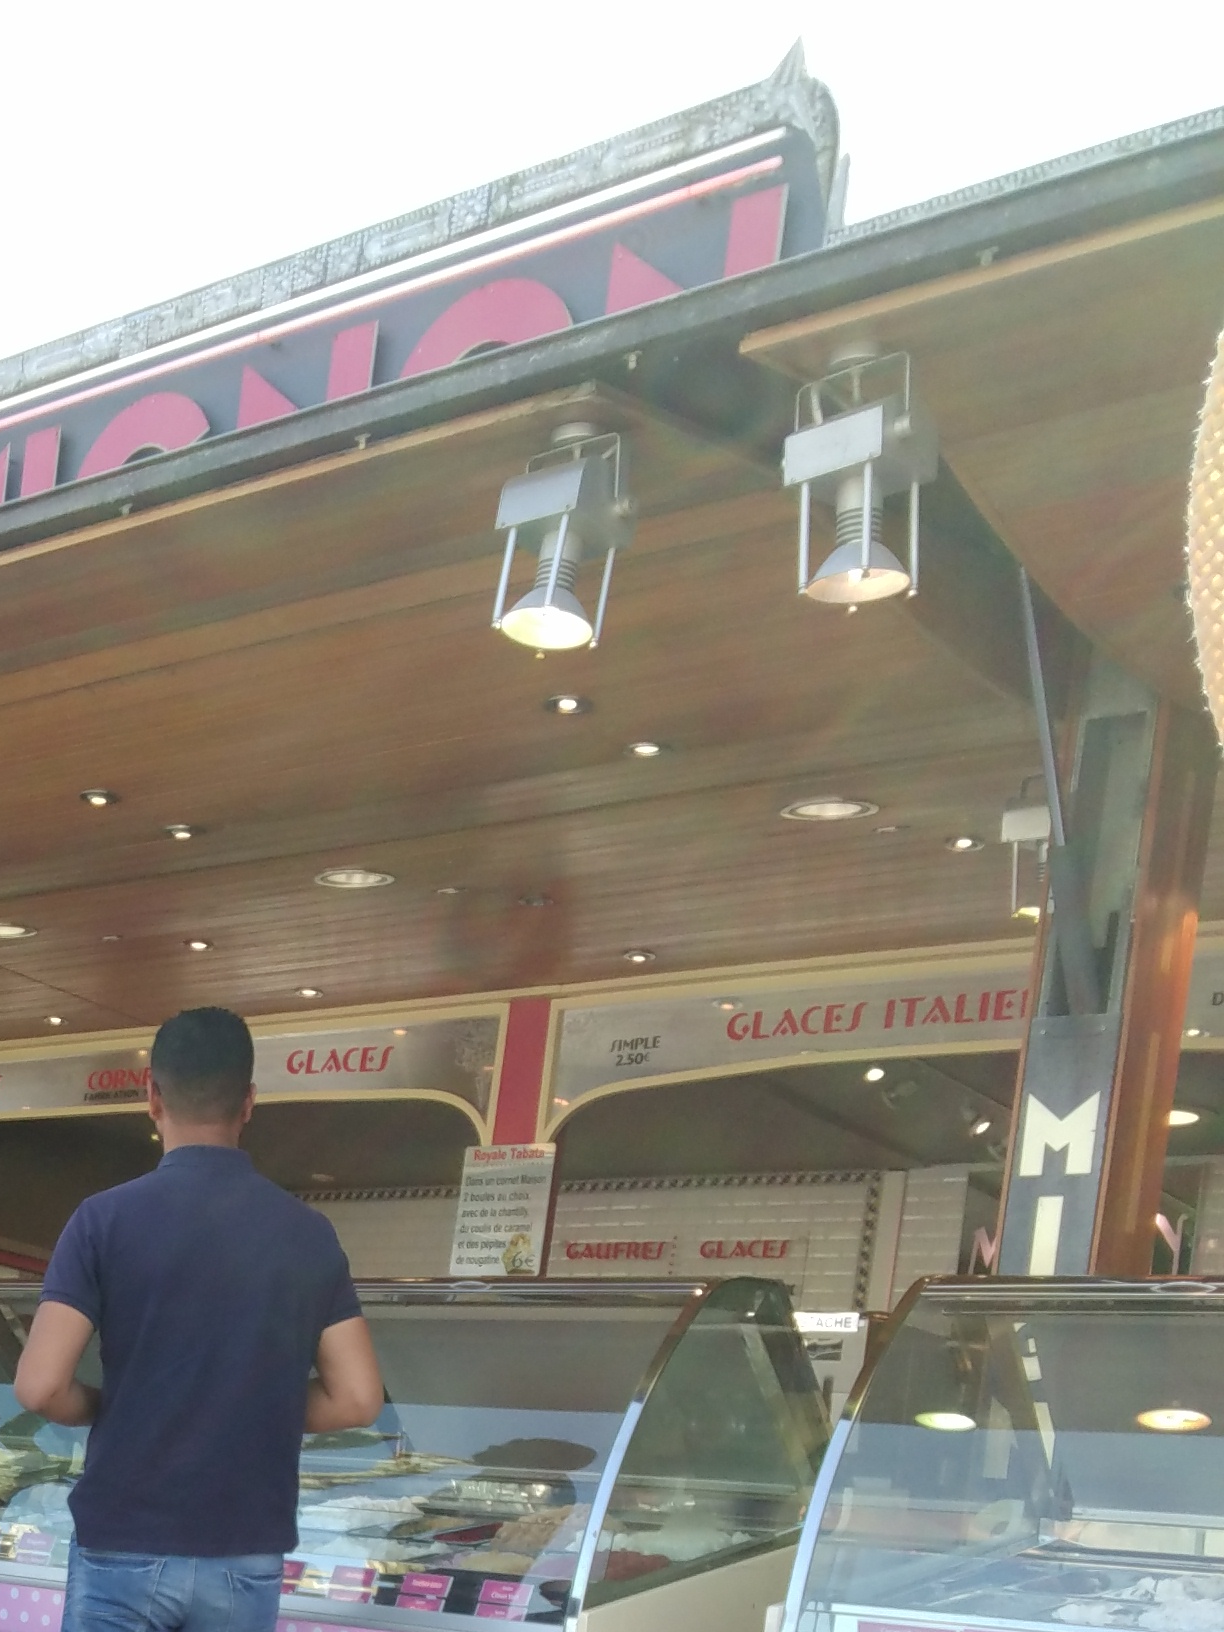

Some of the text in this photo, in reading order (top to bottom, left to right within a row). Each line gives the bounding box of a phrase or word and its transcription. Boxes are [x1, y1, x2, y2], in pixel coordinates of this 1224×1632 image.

[726, 1001, 868, 1041] GLACES
[610, 1036, 661, 1052] SIMPLE
[286, 1046, 394, 1075] GLACES
[474, 1149, 507, 1163] Royale
[470, 1192, 495, 1202] boules
[461, 1209, 478, 1218] avec
[479, 1207, 489, 1217] de
[493, 1223, 502, 1233] de
[504, 1222, 533, 1233] caramel
[566, 1241, 667, 1260] GAUFRES
[700, 1239, 792, 1260] GLACES
[512, 1251, 535, 1268] 6€
